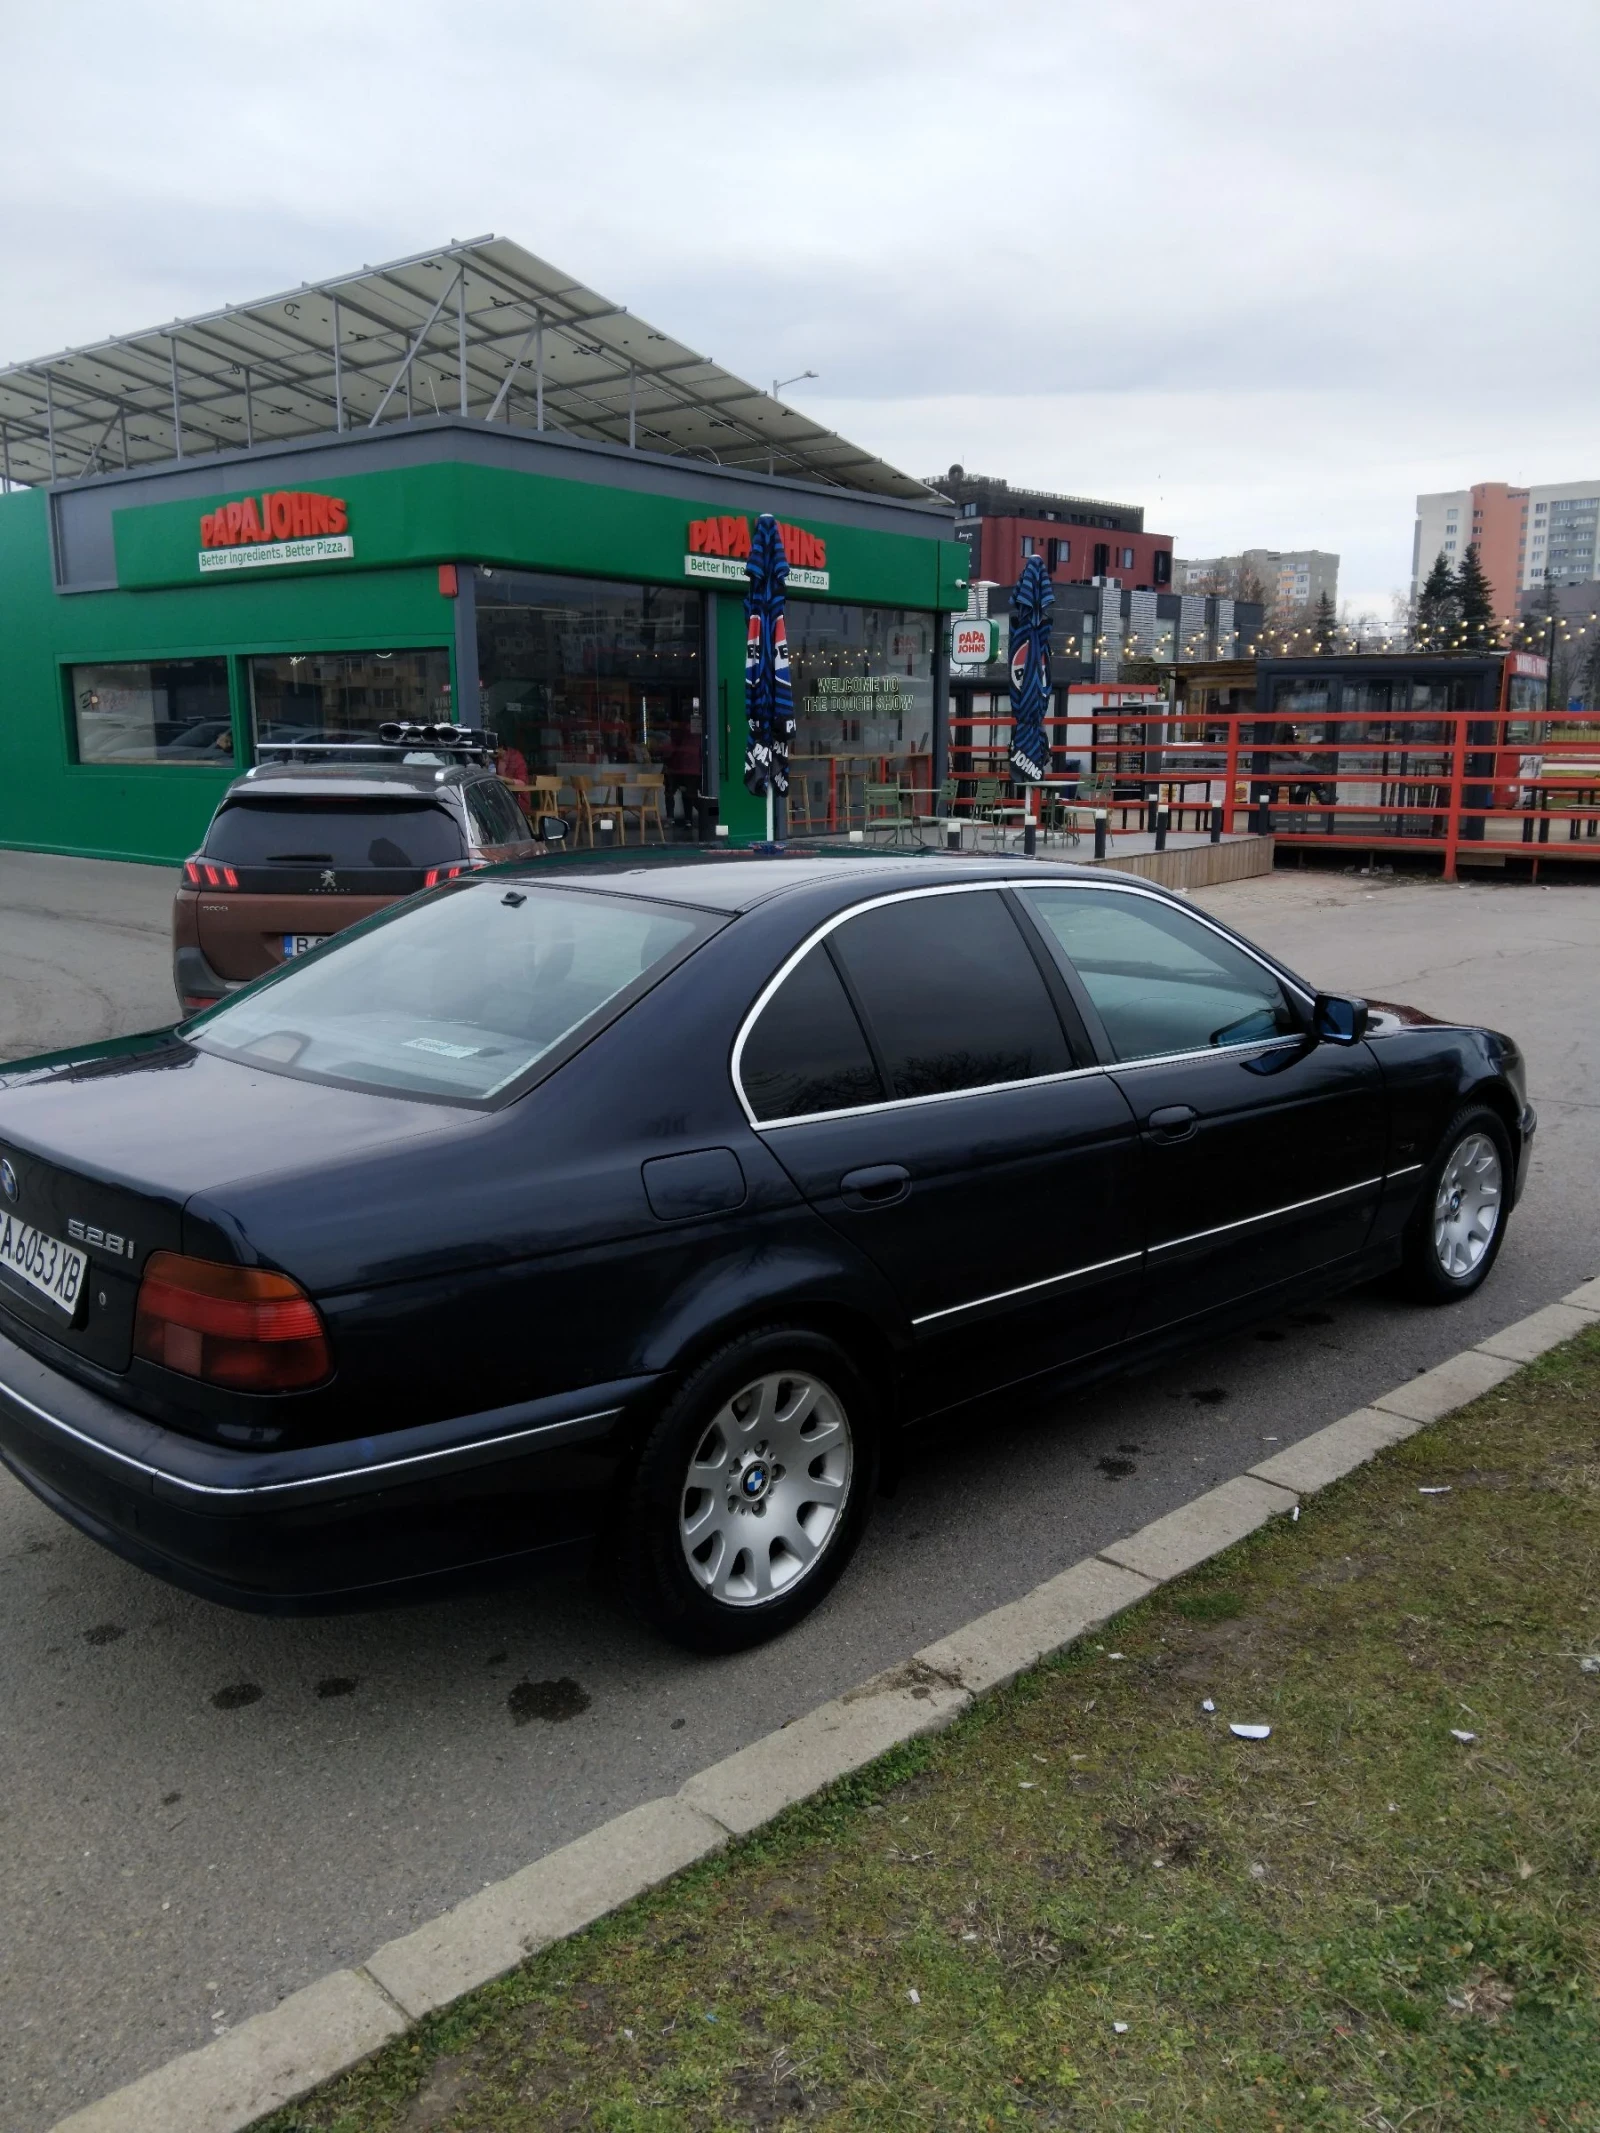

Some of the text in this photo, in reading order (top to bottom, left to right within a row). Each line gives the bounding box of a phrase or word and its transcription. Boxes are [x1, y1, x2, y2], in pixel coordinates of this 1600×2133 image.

[201, 491, 348, 548] PAPA JOHNS
[689, 516, 827, 569] PAPA HNS
[201, 541, 347, 567] Better Ingredients. Better Pizza.
[691, 558, 720, 573] Better
[958, 630, 986, 644] PAPA
[957, 643, 986, 654] JOHNS
[817, 675, 899, 693] WELCOME TO
[803, 695, 914, 712] THE DOUGH SHOW
[1010, 750, 1042, 780] JOHNS
